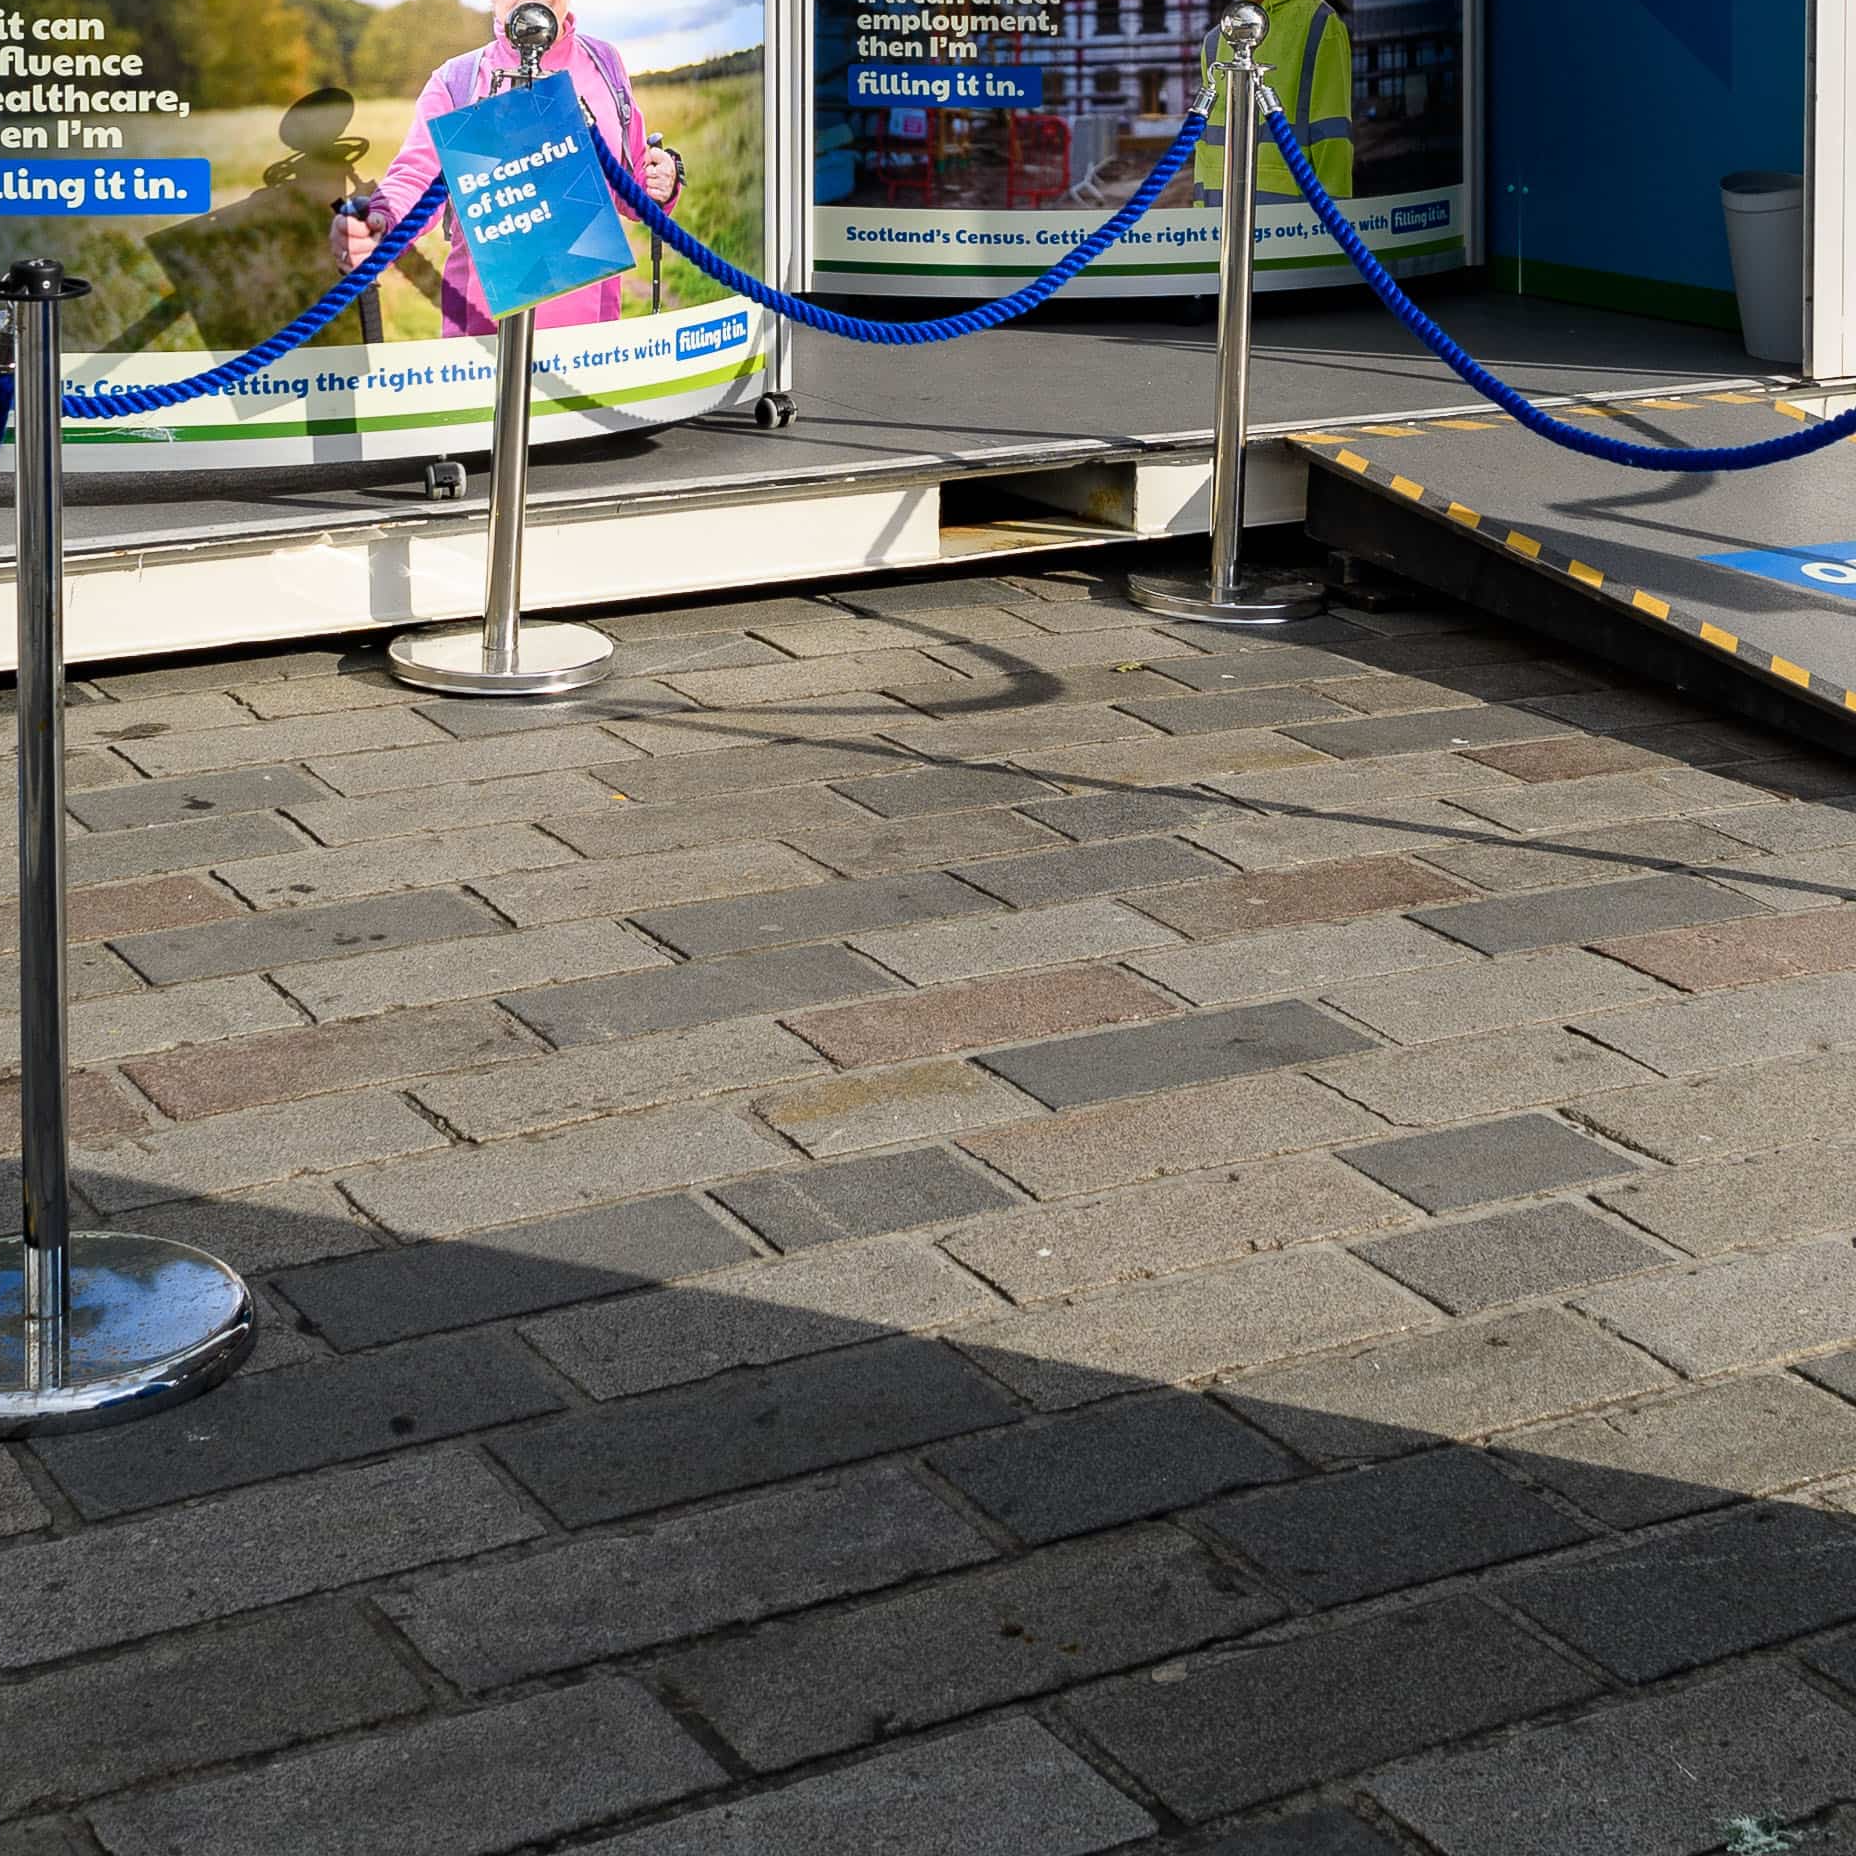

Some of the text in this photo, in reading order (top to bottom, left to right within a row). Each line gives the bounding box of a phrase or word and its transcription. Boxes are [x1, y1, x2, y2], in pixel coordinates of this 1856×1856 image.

[32, 17, 105, 41] can
[857, 10, 1058, 37] employment,
[857, 36, 977, 58] then I'm
[858, 72, 1024, 102] filling it in.
[57, 120, 123, 149] I'm
[457, 135, 579, 195] Be careful
[94, 168, 125, 200] it
[134, 168, 188, 200] in.
[467, 182, 537, 219] of the
[474, 200, 552, 244] ledge!
[846, 226, 950, 244] Scotland's
[955, 229, 1031, 245] Census.
[1120, 228, 1152, 244] the
[1157, 226, 1207, 247] right
[1275, 223, 1308, 239] out,
[1359, 215, 1388, 232] with
[1394, 207, 1427, 227] filling
[316, 372, 360, 392] the
[366, 364, 434, 393] right
[572, 345, 630, 369] starts
[634, 338, 671, 360] with
[680, 327, 721, 352] filling
[722, 320, 732, 342] it
[732, 318, 746, 339] in.
